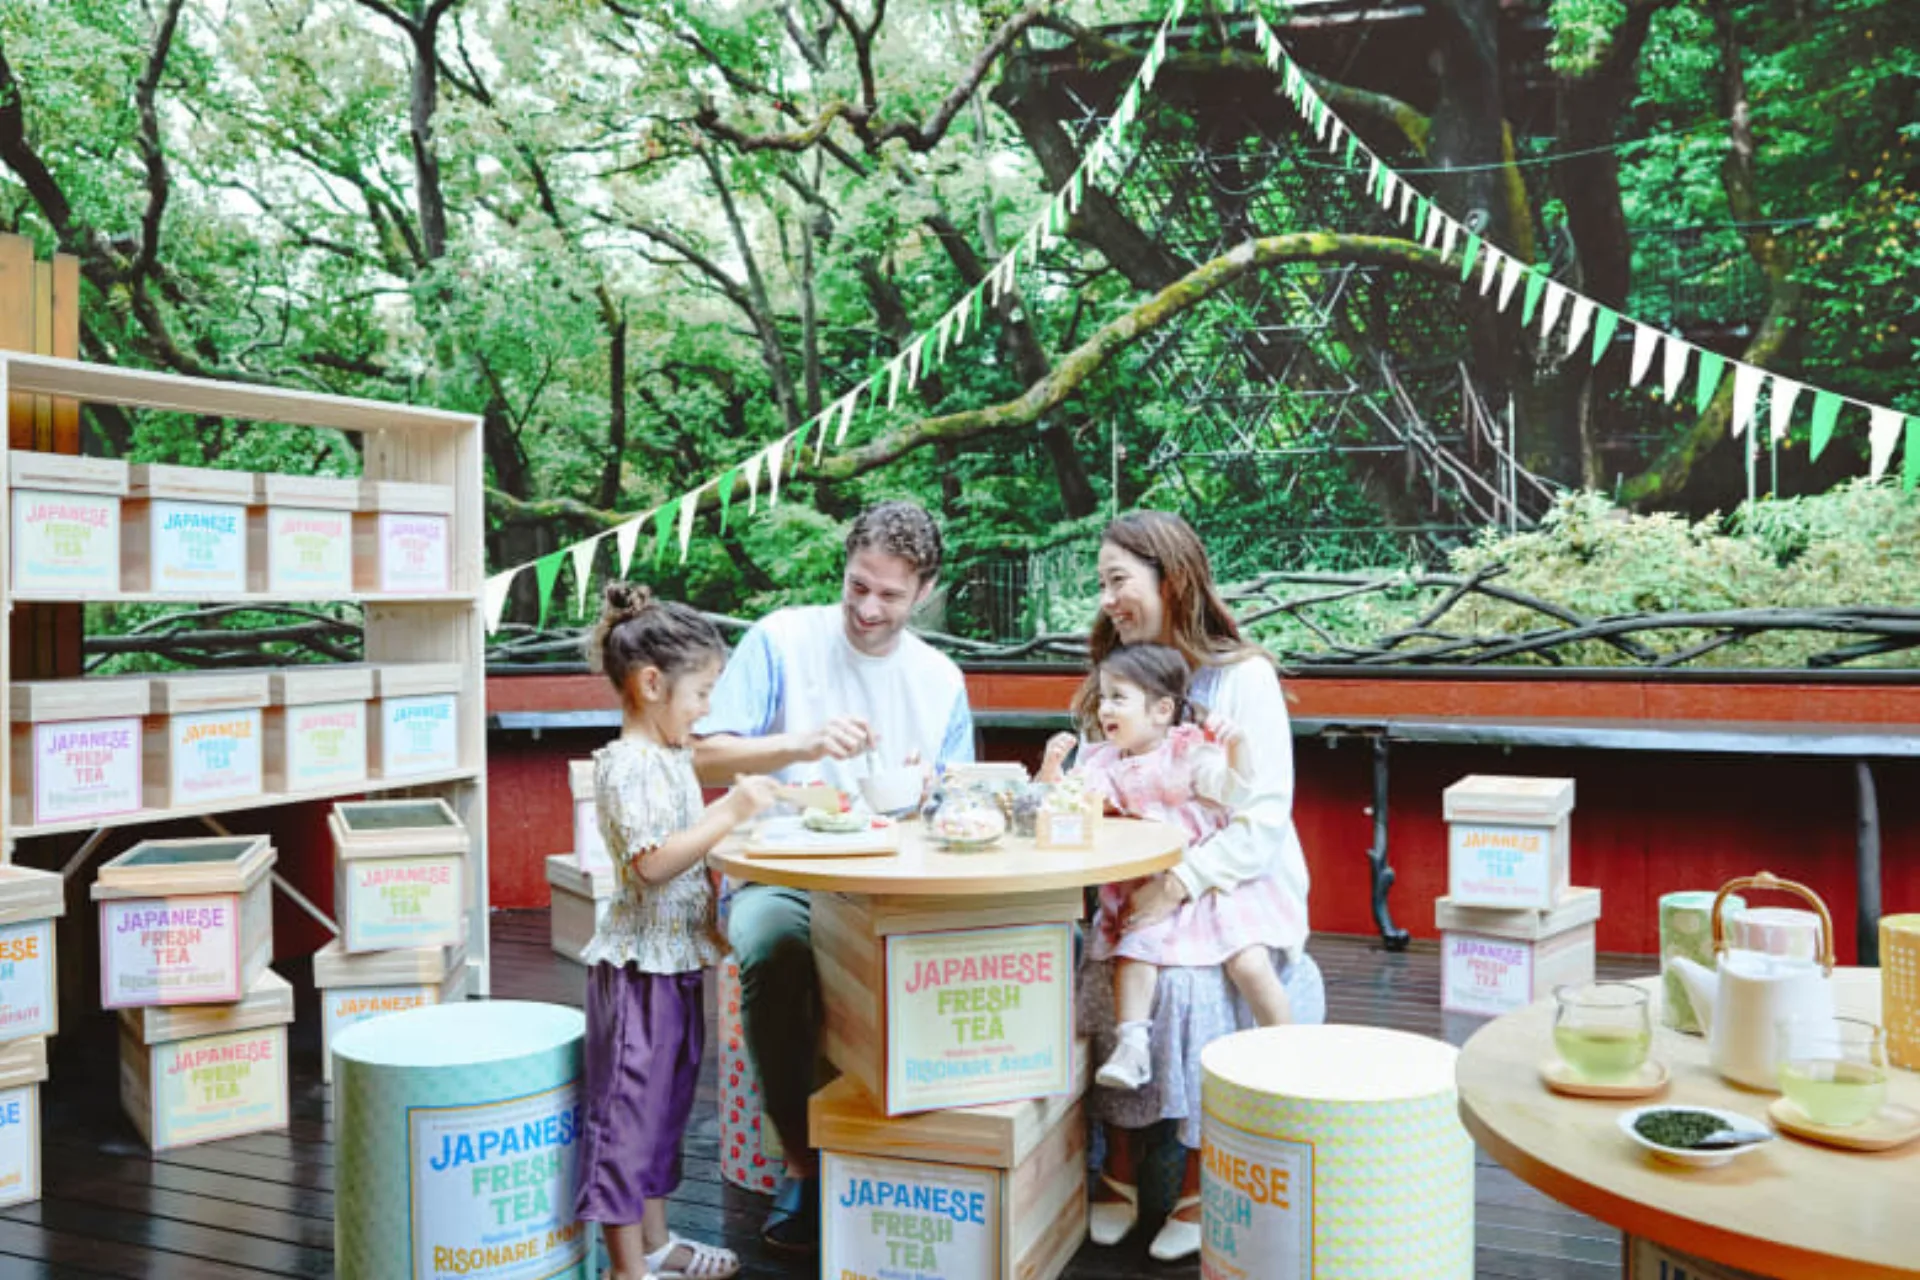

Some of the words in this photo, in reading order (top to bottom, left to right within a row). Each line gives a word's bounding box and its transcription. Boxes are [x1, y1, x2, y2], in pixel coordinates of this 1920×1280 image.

[163, 512, 236, 534] JAPANESE
[48, 730, 130, 754] JAPANESE
[182, 720, 252, 743] JAPANESE
[360, 866, 451, 887] JAPANESE
[117, 907, 224, 933] JAPANESE
[153, 947, 191, 966] TEA
[905, 952, 1053, 993] JAPANESE
[938, 984, 1021, 1015] FRESH
[951, 1015, 1005, 1044] TEA
[168, 1040, 273, 1075] JAPANESE
[472, 1151, 563, 1196] FRESH
[490, 1188, 551, 1225] TEA
[840, 1178, 985, 1225] JAPANESE
[871, 1211, 953, 1245] FRESH
[434, 1238, 540, 1273] RISONARE
[886, 1241, 937, 1270] TEA
